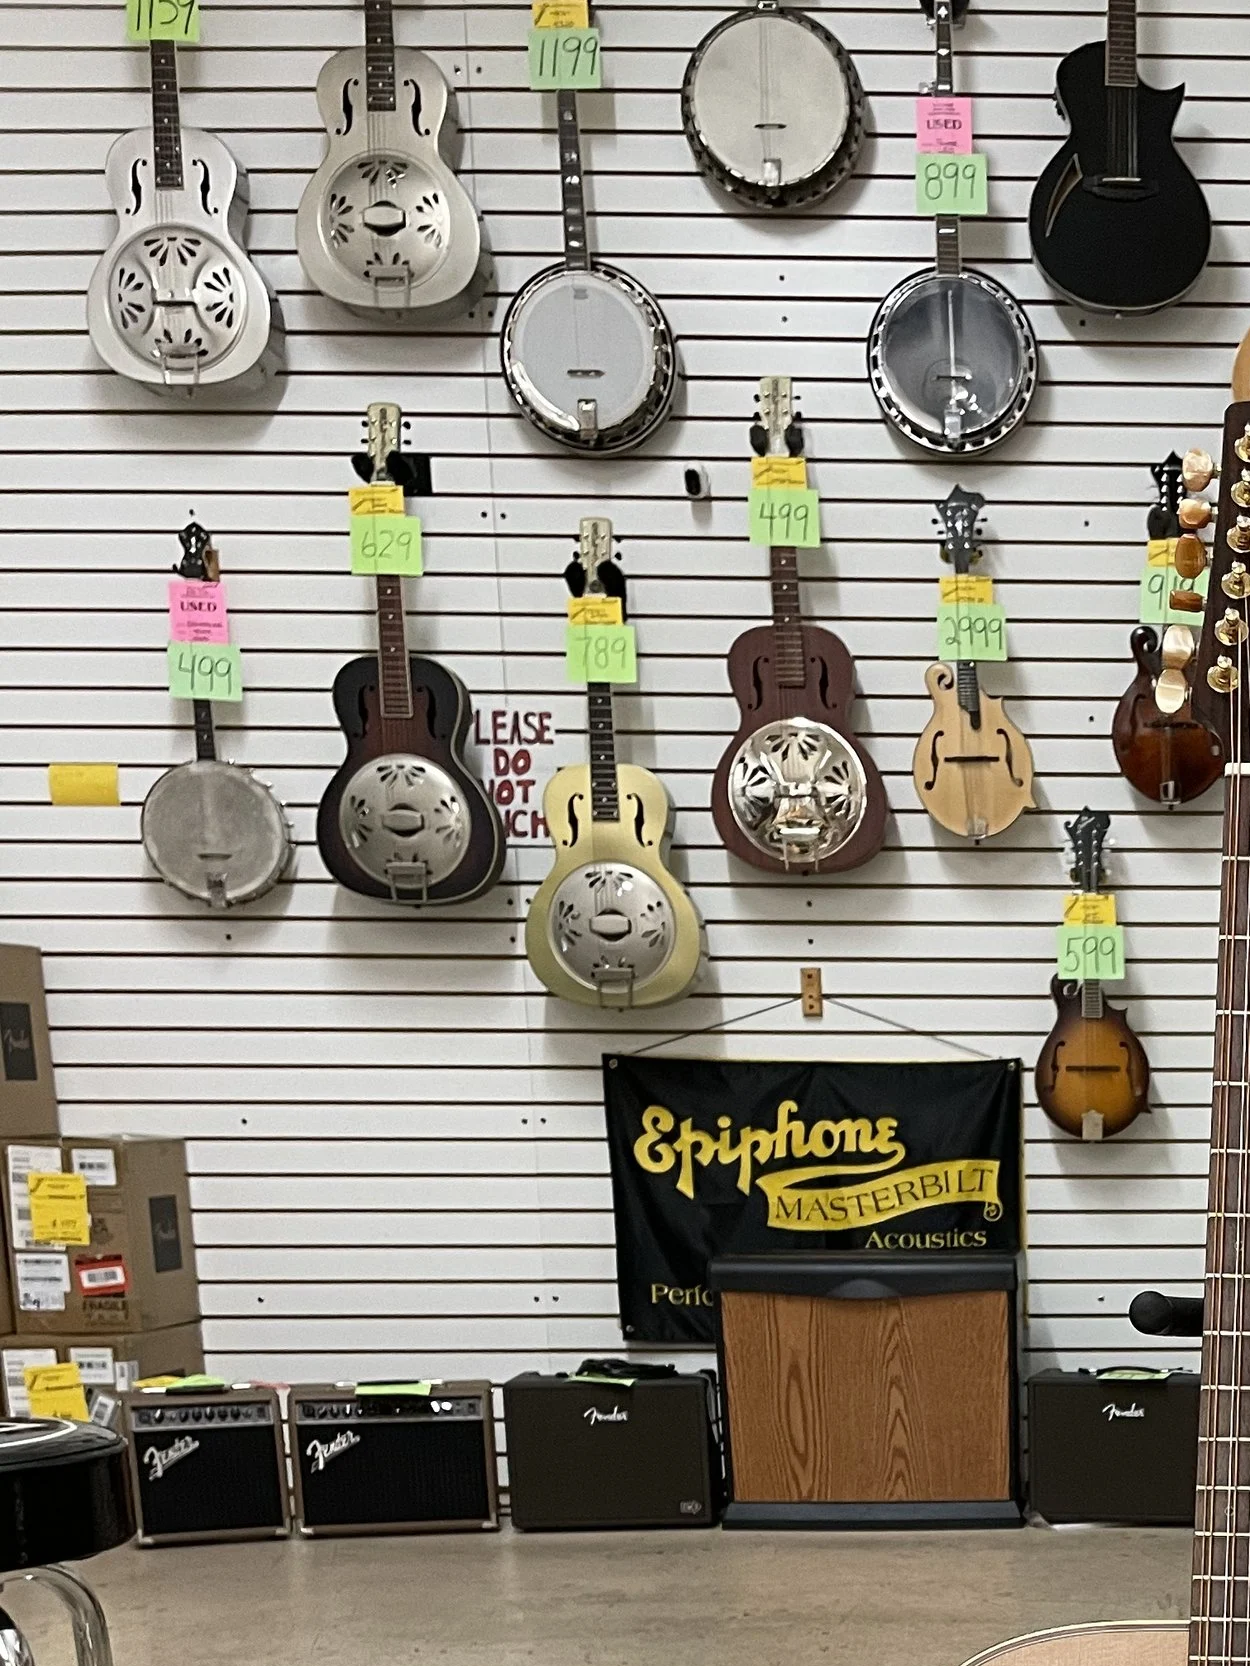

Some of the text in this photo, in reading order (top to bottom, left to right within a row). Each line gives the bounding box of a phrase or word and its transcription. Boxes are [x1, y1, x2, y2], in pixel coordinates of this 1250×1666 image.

[539, 36, 598, 77] 1199
[927, 119, 962, 130] USED
[924, 162, 976, 200] 899
[759, 502, 809, 541] 499
[361, 529, 412, 560] 629
[180, 601, 217, 612] USED
[943, 616, 1002, 651] 2999
[575, 636, 626, 670] 789
[178, 652, 232, 696] 499
[473, 709, 554, 745] LEASE
[493, 747, 532, 777] DO
[1063, 936, 1117, 975] 599
[633, 1099, 906, 1200] Epiphone
[775, 1167, 994, 1223] MASTERBILT
[583, 1405, 629, 1426] Fender
[1102, 1403, 1145, 1422] Fender
[144, 1435, 200, 1480] Fender
[306, 1430, 361, 1474] Fender
